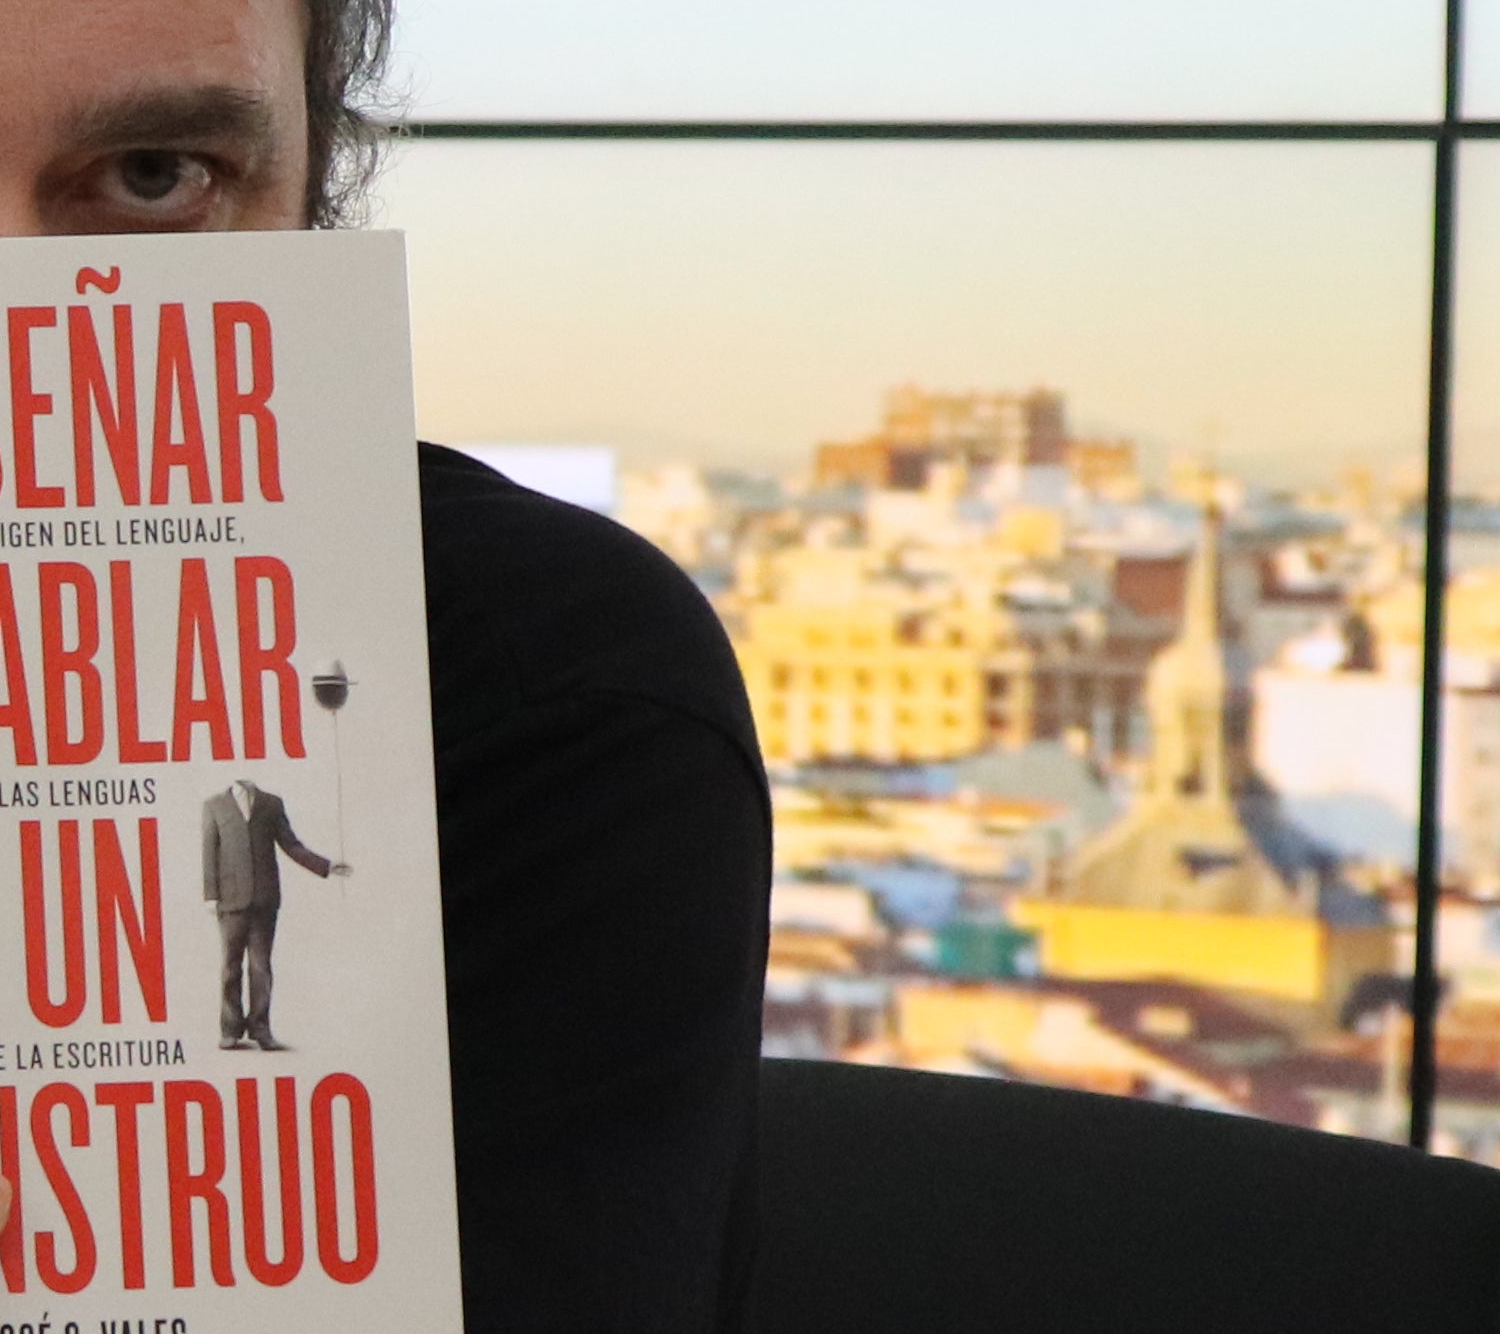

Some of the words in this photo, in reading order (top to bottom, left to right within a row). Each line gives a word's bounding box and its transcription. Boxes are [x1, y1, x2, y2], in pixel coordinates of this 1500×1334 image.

[64, 520, 106, 547] DEL
[116, 516, 246, 546] LENGUAJE,
[49, 778, 156, 807] LENGUAS
[19, 817, 168, 1028] UN
[16, 1043, 43, 1070] LA
[53, 1039, 186, 1069] ESCRITURA
